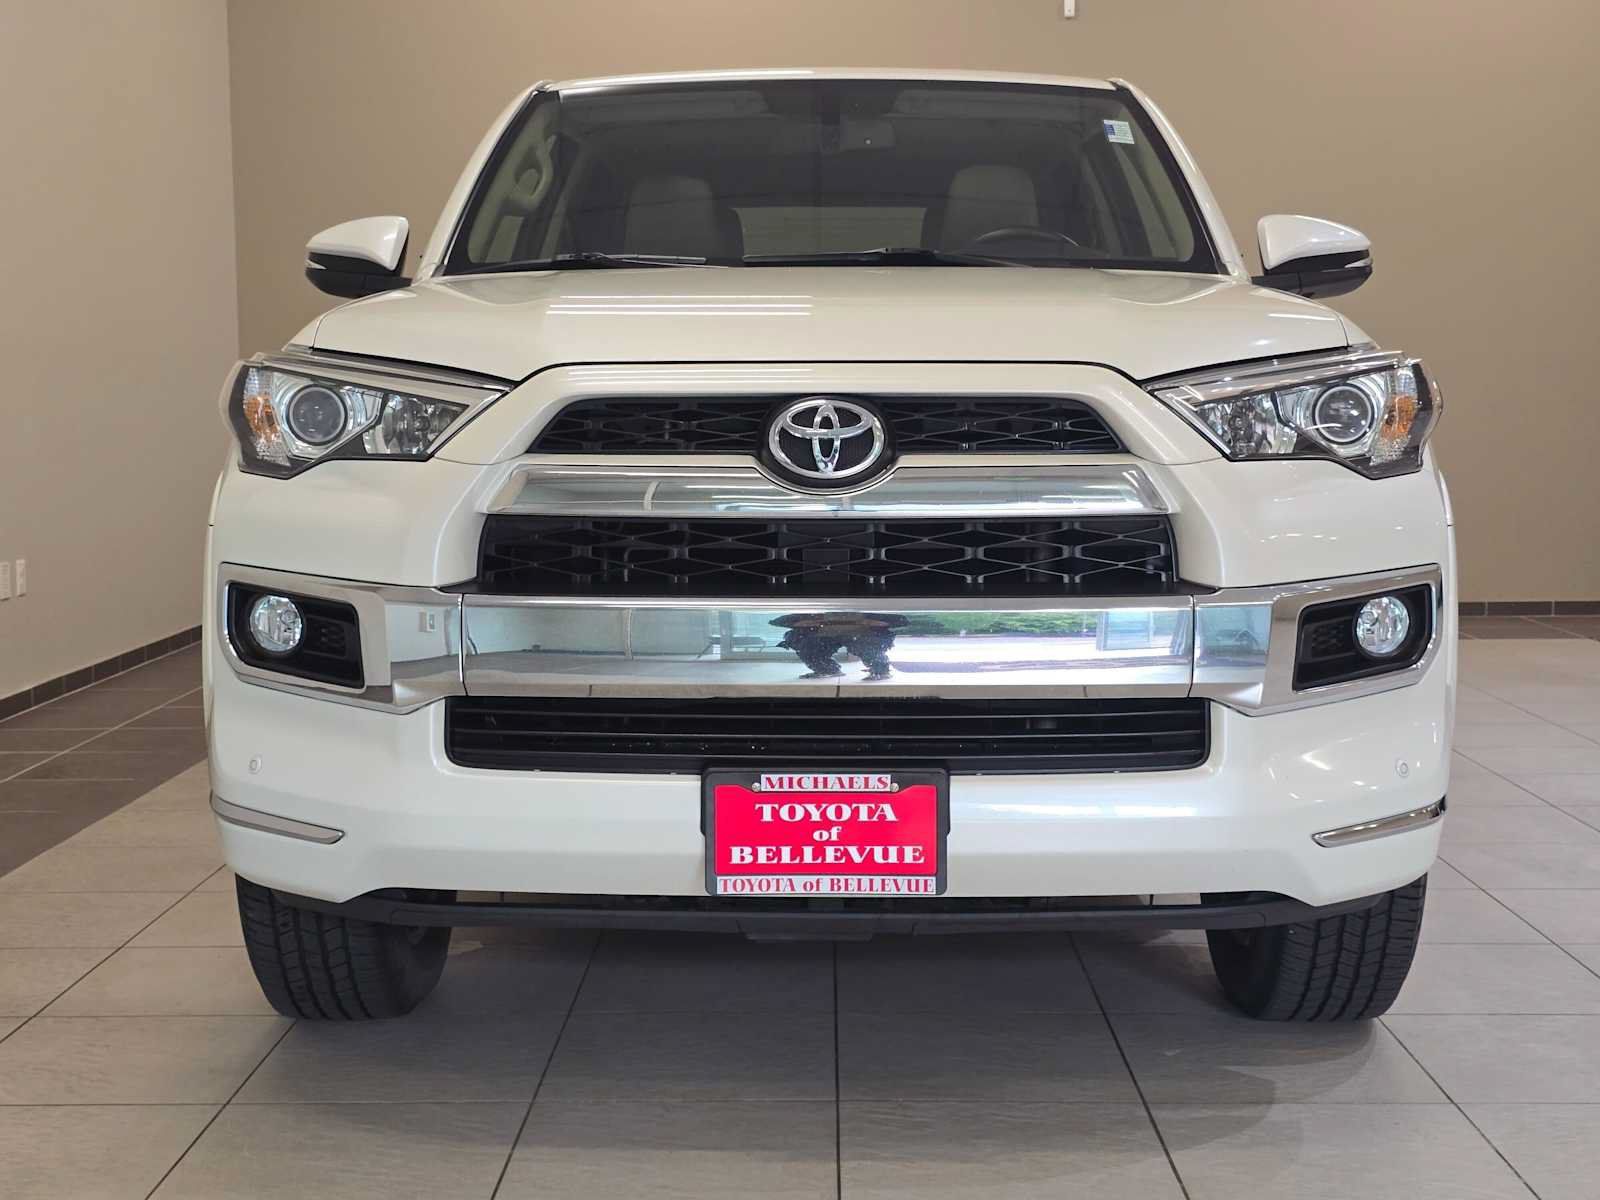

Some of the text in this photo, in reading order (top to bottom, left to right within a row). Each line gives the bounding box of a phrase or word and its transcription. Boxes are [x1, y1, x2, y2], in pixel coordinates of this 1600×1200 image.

[765, 776, 889, 790] MICHAELS
[755, 803, 897, 822] TOYOTA
[812, 826, 842, 842] of
[729, 845, 925, 864] BELLEVUE
[719, 877, 934, 893] TOYOTA of BELLEVUE
